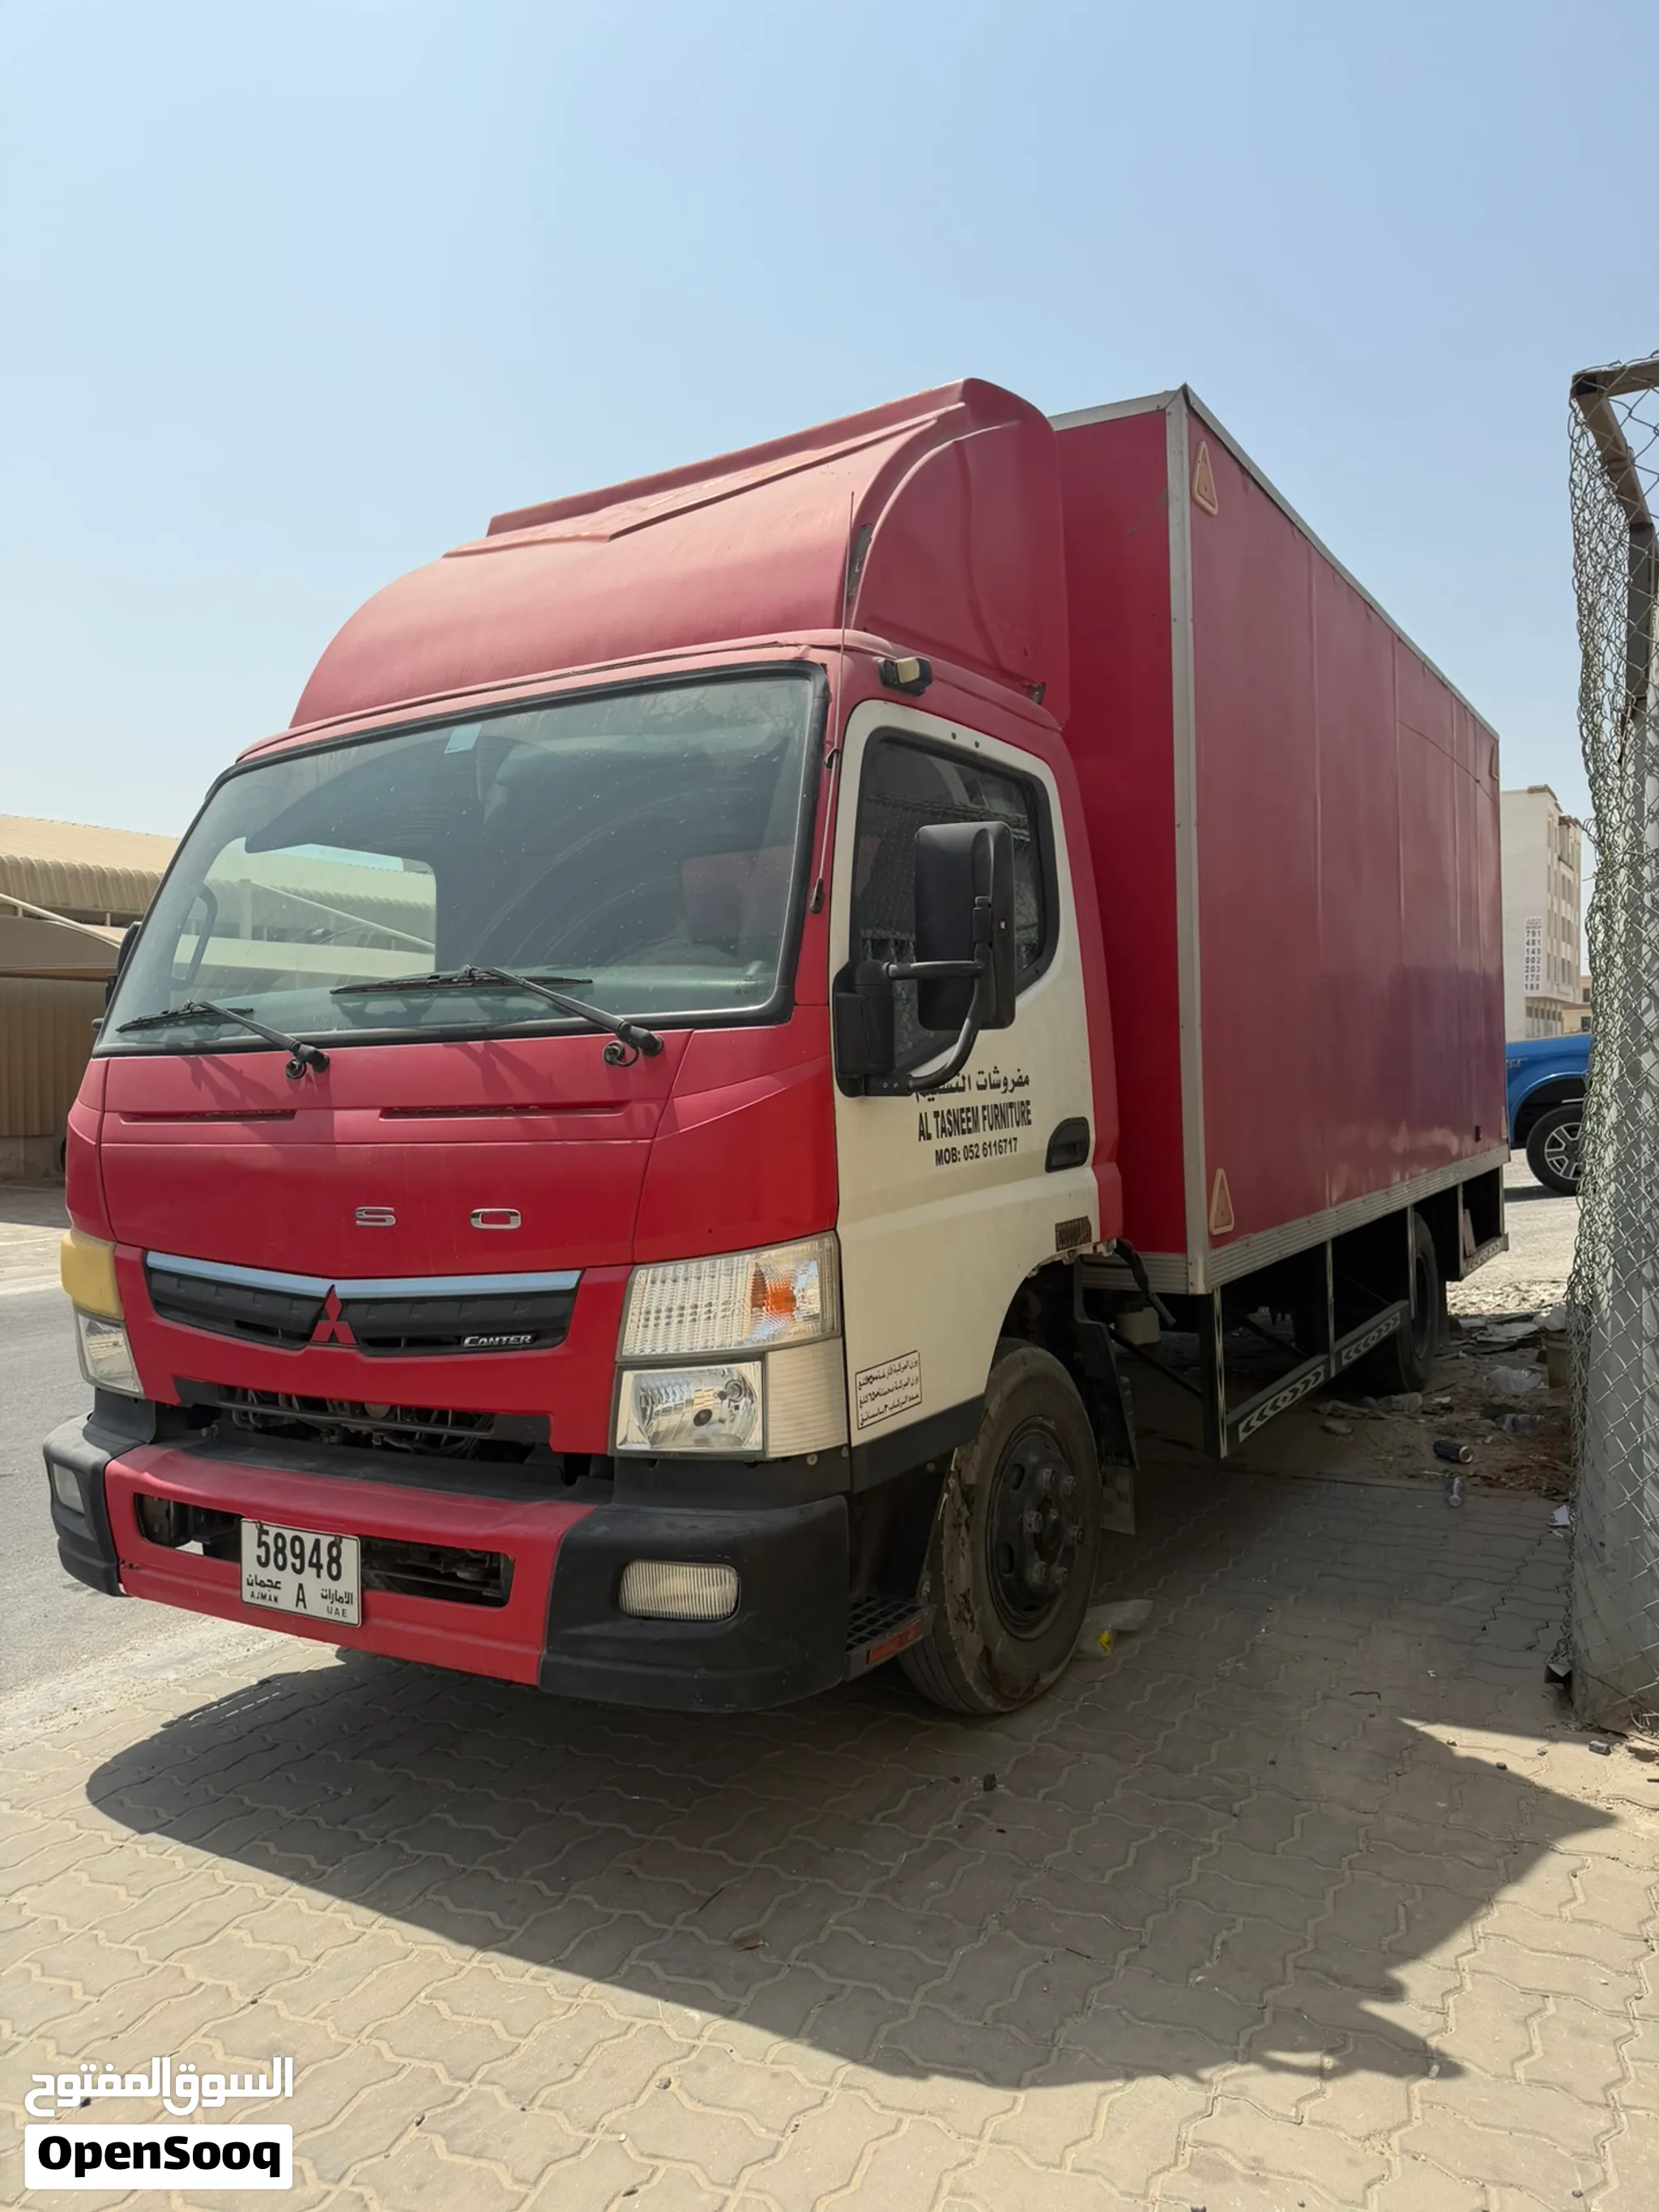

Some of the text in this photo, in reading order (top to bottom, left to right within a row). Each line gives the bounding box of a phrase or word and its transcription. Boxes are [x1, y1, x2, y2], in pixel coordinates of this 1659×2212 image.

[976, 1066, 1030, 1093] مفروشات
[919, 1099, 1032, 1142] AL TASNEEM FURNITURE
[935, 1136, 1018, 1167] MOB: 052 6116717
[356, 1206, 397, 1227] S
[256, 1526, 342, 1582] 58948
[246, 1574, 282, 1592] عجمان
[250, 1591, 279, 1604] AJMAN
[295, 1583, 307, 1610] A
[320, 1588, 354, 1605] الامارات
[326, 1605, 348, 1618] UAE
